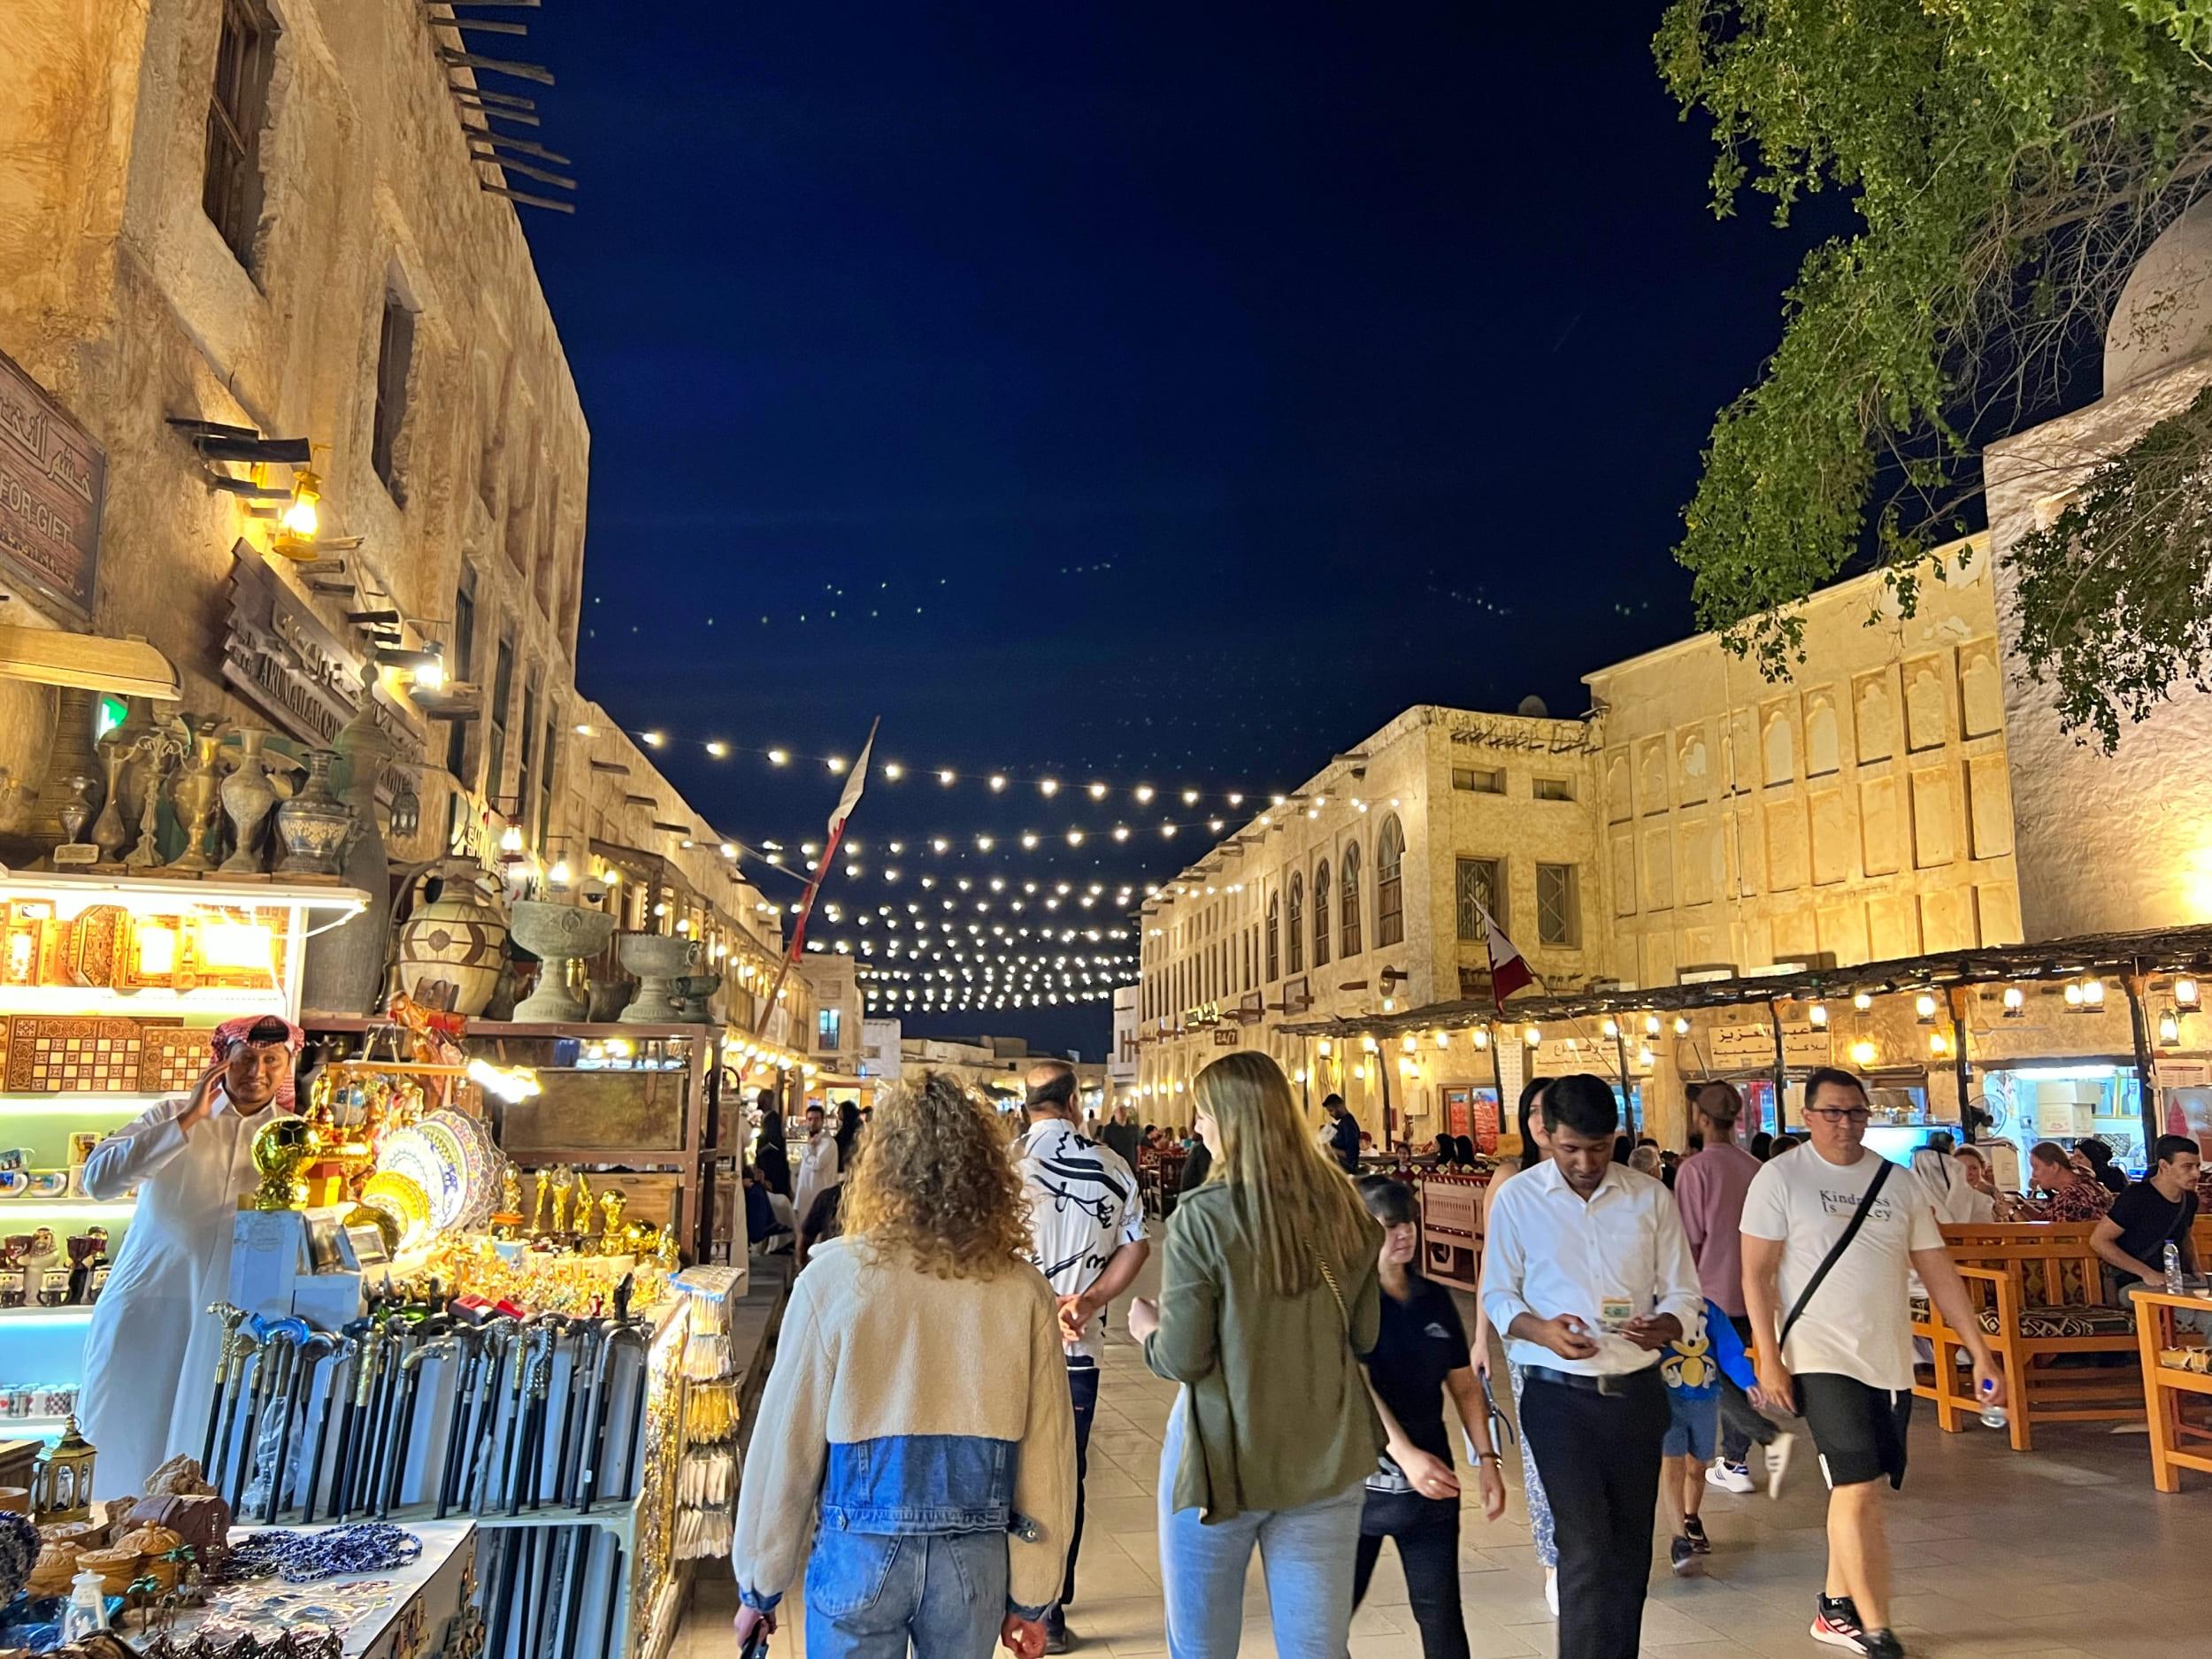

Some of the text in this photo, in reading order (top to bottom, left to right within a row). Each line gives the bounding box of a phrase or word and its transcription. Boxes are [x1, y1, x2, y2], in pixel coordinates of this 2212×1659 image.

[0, 474, 71, 549] FOR GIFT
[1216, 1031, 1236, 1045] 24/7
[1819, 1190, 1891, 1207] Kindss
